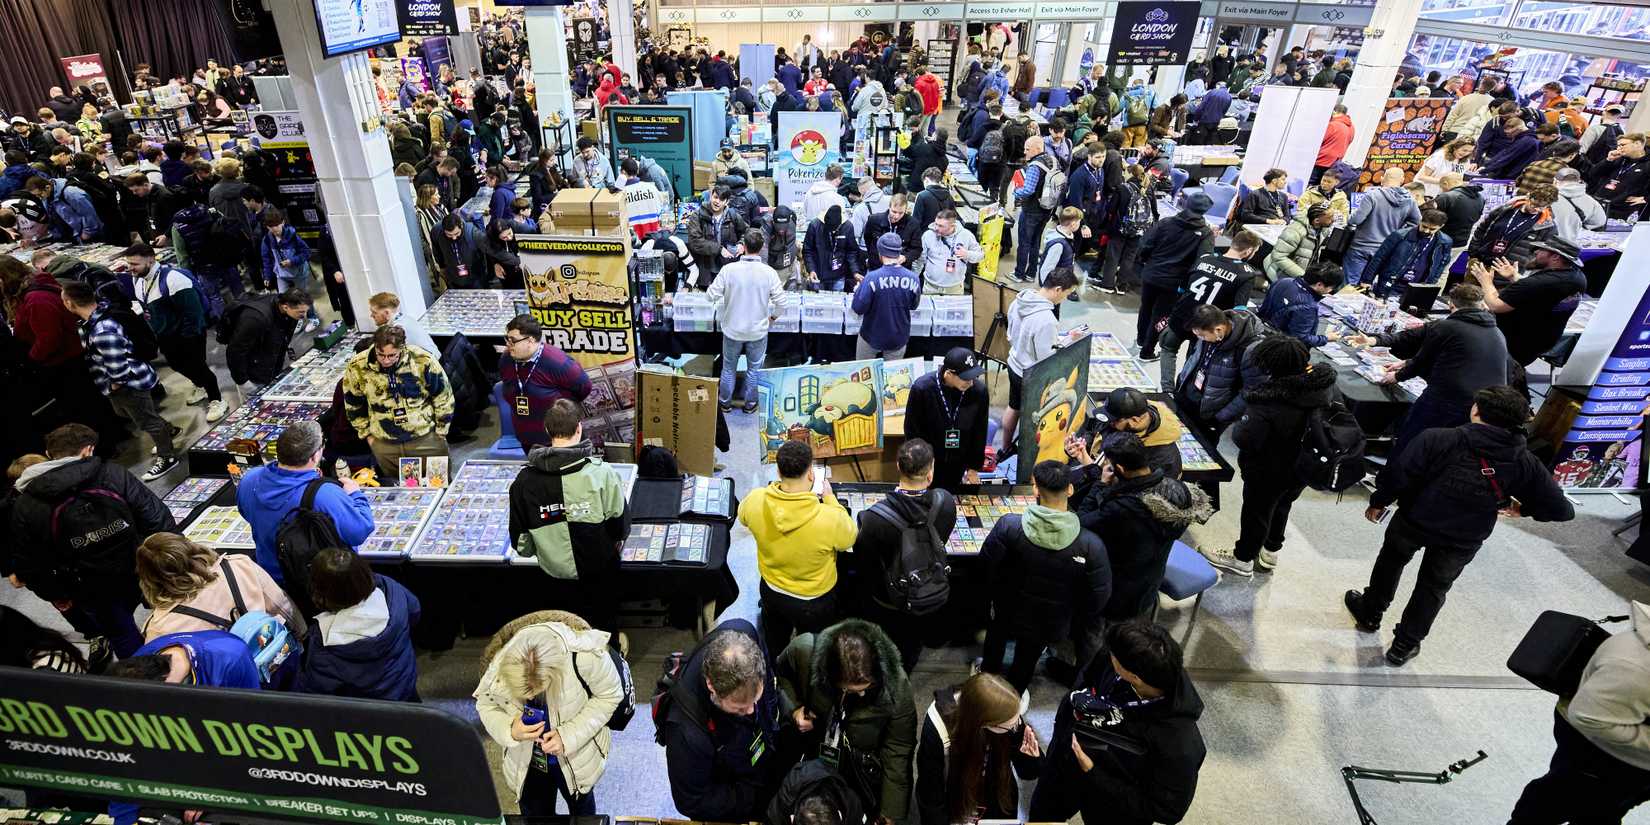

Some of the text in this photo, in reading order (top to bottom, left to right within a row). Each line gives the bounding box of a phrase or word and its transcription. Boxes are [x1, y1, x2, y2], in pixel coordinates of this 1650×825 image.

[1131, 24, 1178, 32] LONDON
[788, 168, 824, 178] Pokerizo
[626, 189, 655, 202] ildish
[518, 242, 622, 252] @THEEEVEEDAYCOLLECTOR
[870, 276, 919, 293] I KNOW
[1190, 276, 1222, 305] 41
[530, 309, 630, 328] BUY SELL
[1618, 360, 1648, 369] Singles
[1610, 374, 1642, 384] Grading
[1602, 388, 1646, 397] Box Breaks
[1594, 403, 1638, 412] Sealed Wax
[1586, 417, 1632, 426] Memorabilia
[1578, 432, 1628, 441] Consignment
[65, 706, 204, 753] DOWN
[202, 720, 420, 774] DISPLAYS
[5, 739, 136, 764] 3RDDOWN.CO.UK
[248, 767, 428, 796] @3RDDOWNDISPLAYS
[56, 775, 89, 786] CARD
[90, 779, 124, 791] CARE
[138, 784, 170, 797] SLAB
[172, 788, 249, 805] PROTECTION
[265, 799, 323, 814] BREAKER
[325, 806, 348, 816] SET
[352, 810, 379, 820] UPS
[396, 814, 456, 825] DISPLAYS
